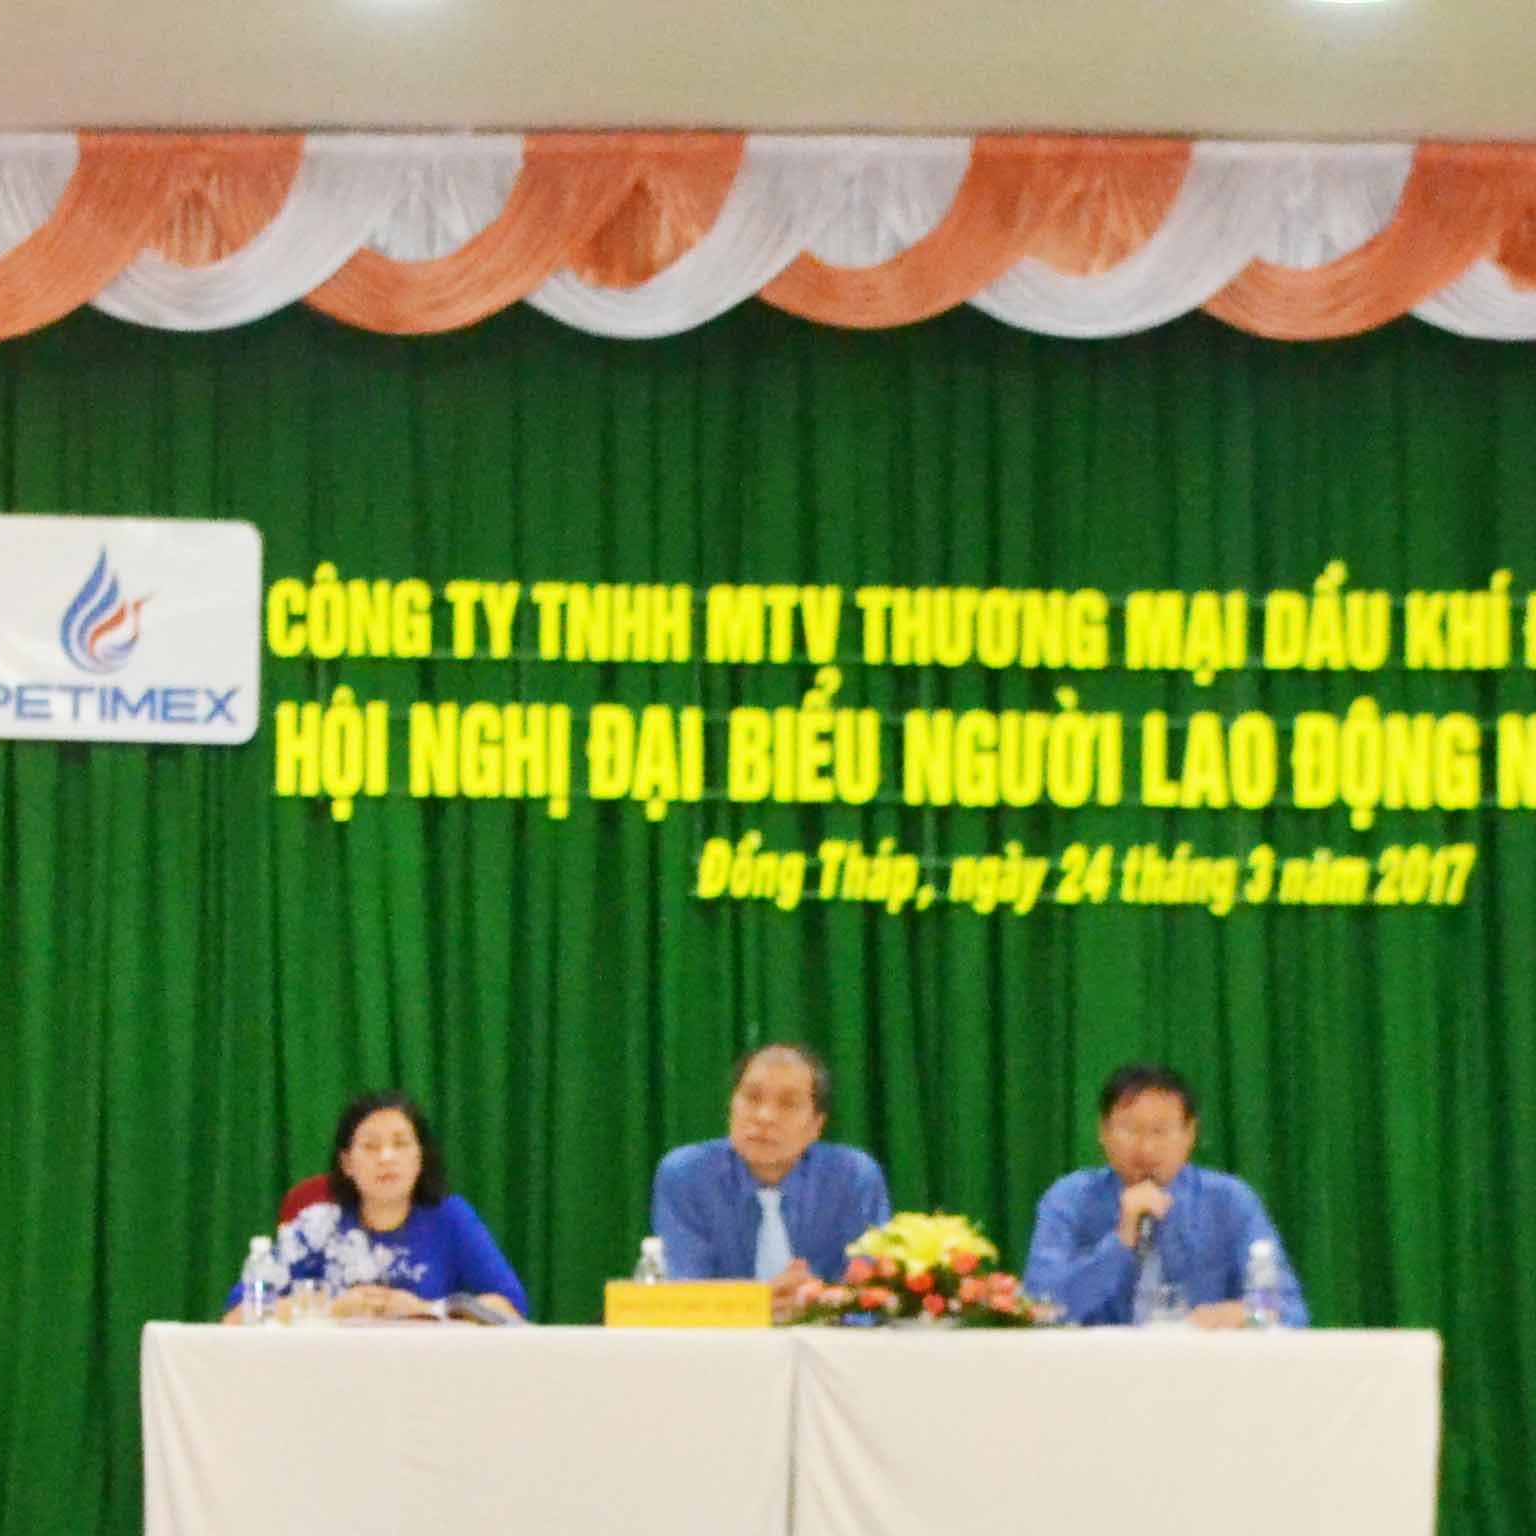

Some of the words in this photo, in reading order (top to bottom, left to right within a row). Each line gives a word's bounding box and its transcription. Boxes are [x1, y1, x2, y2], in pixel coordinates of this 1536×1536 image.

[267, 561, 433, 660] CÔNG
[443, 579, 522, 660] TY
[529, 580, 693, 663] TNHH
[705, 583, 842, 664] MTV
[854, 585, 1110, 670] THƯƠNG
[1124, 589, 1248, 687] MẠI
[1404, 568, 1513, 671] KHÍ
[274, 685, 390, 823] HỘI
[408, 701, 572, 820] NGHỊ
[585, 702, 705, 822] ĐẠI
[727, 666, 882, 805] BIỂU
[902, 686, 1123, 808] NGƯỜI
[1140, 710, 1278, 810] LAO
[1290, 695, 1482, 831] ĐỘNG
[948, 840, 1050, 915] ngày
[1054, 842, 1114, 904] 24
[1119, 841, 1239, 917] tháng
[1243, 843, 1276, 904] 3
[1279, 846, 1371, 905] năm
[1373, 842, 1477, 906] 2017
